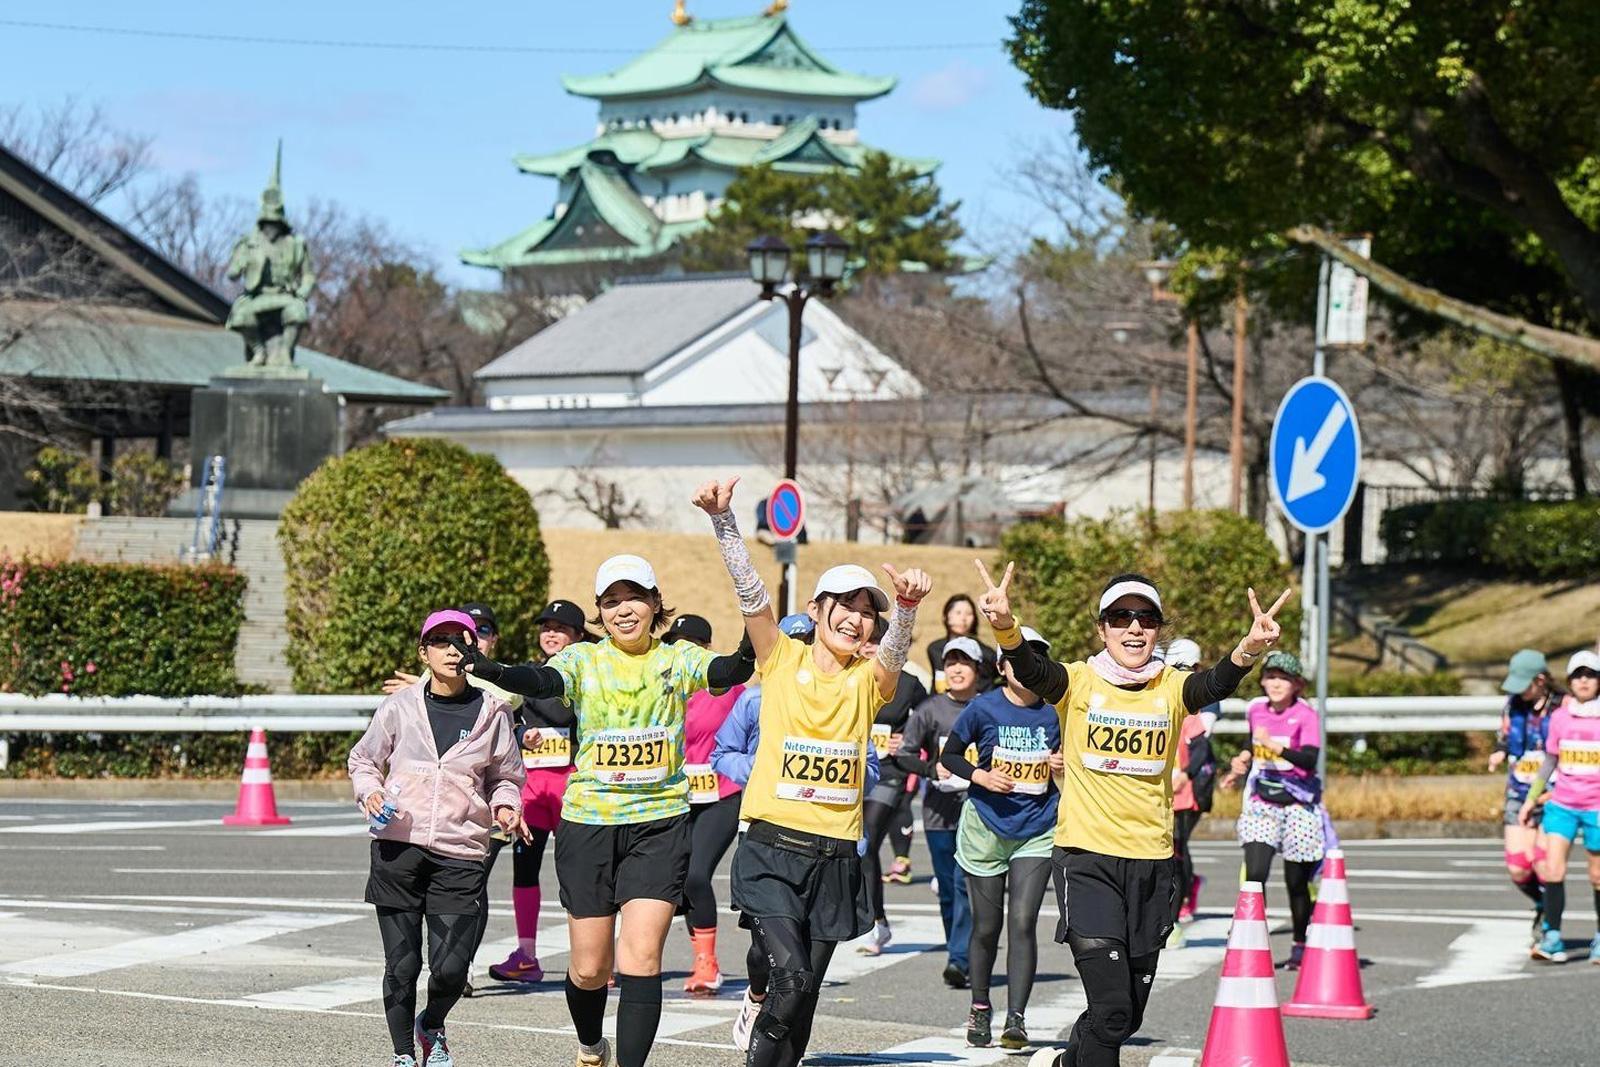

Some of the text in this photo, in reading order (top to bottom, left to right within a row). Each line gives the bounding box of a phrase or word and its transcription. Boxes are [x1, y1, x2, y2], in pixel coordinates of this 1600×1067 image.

[1088, 713, 1126, 726] Niterra
[998, 725, 1032, 738] NAGOYA
[1087, 724, 1166, 756] K26610
[595, 740, 664, 767] I23237
[784, 741, 822, 754] Niterra
[781, 753, 858, 784] K25621
